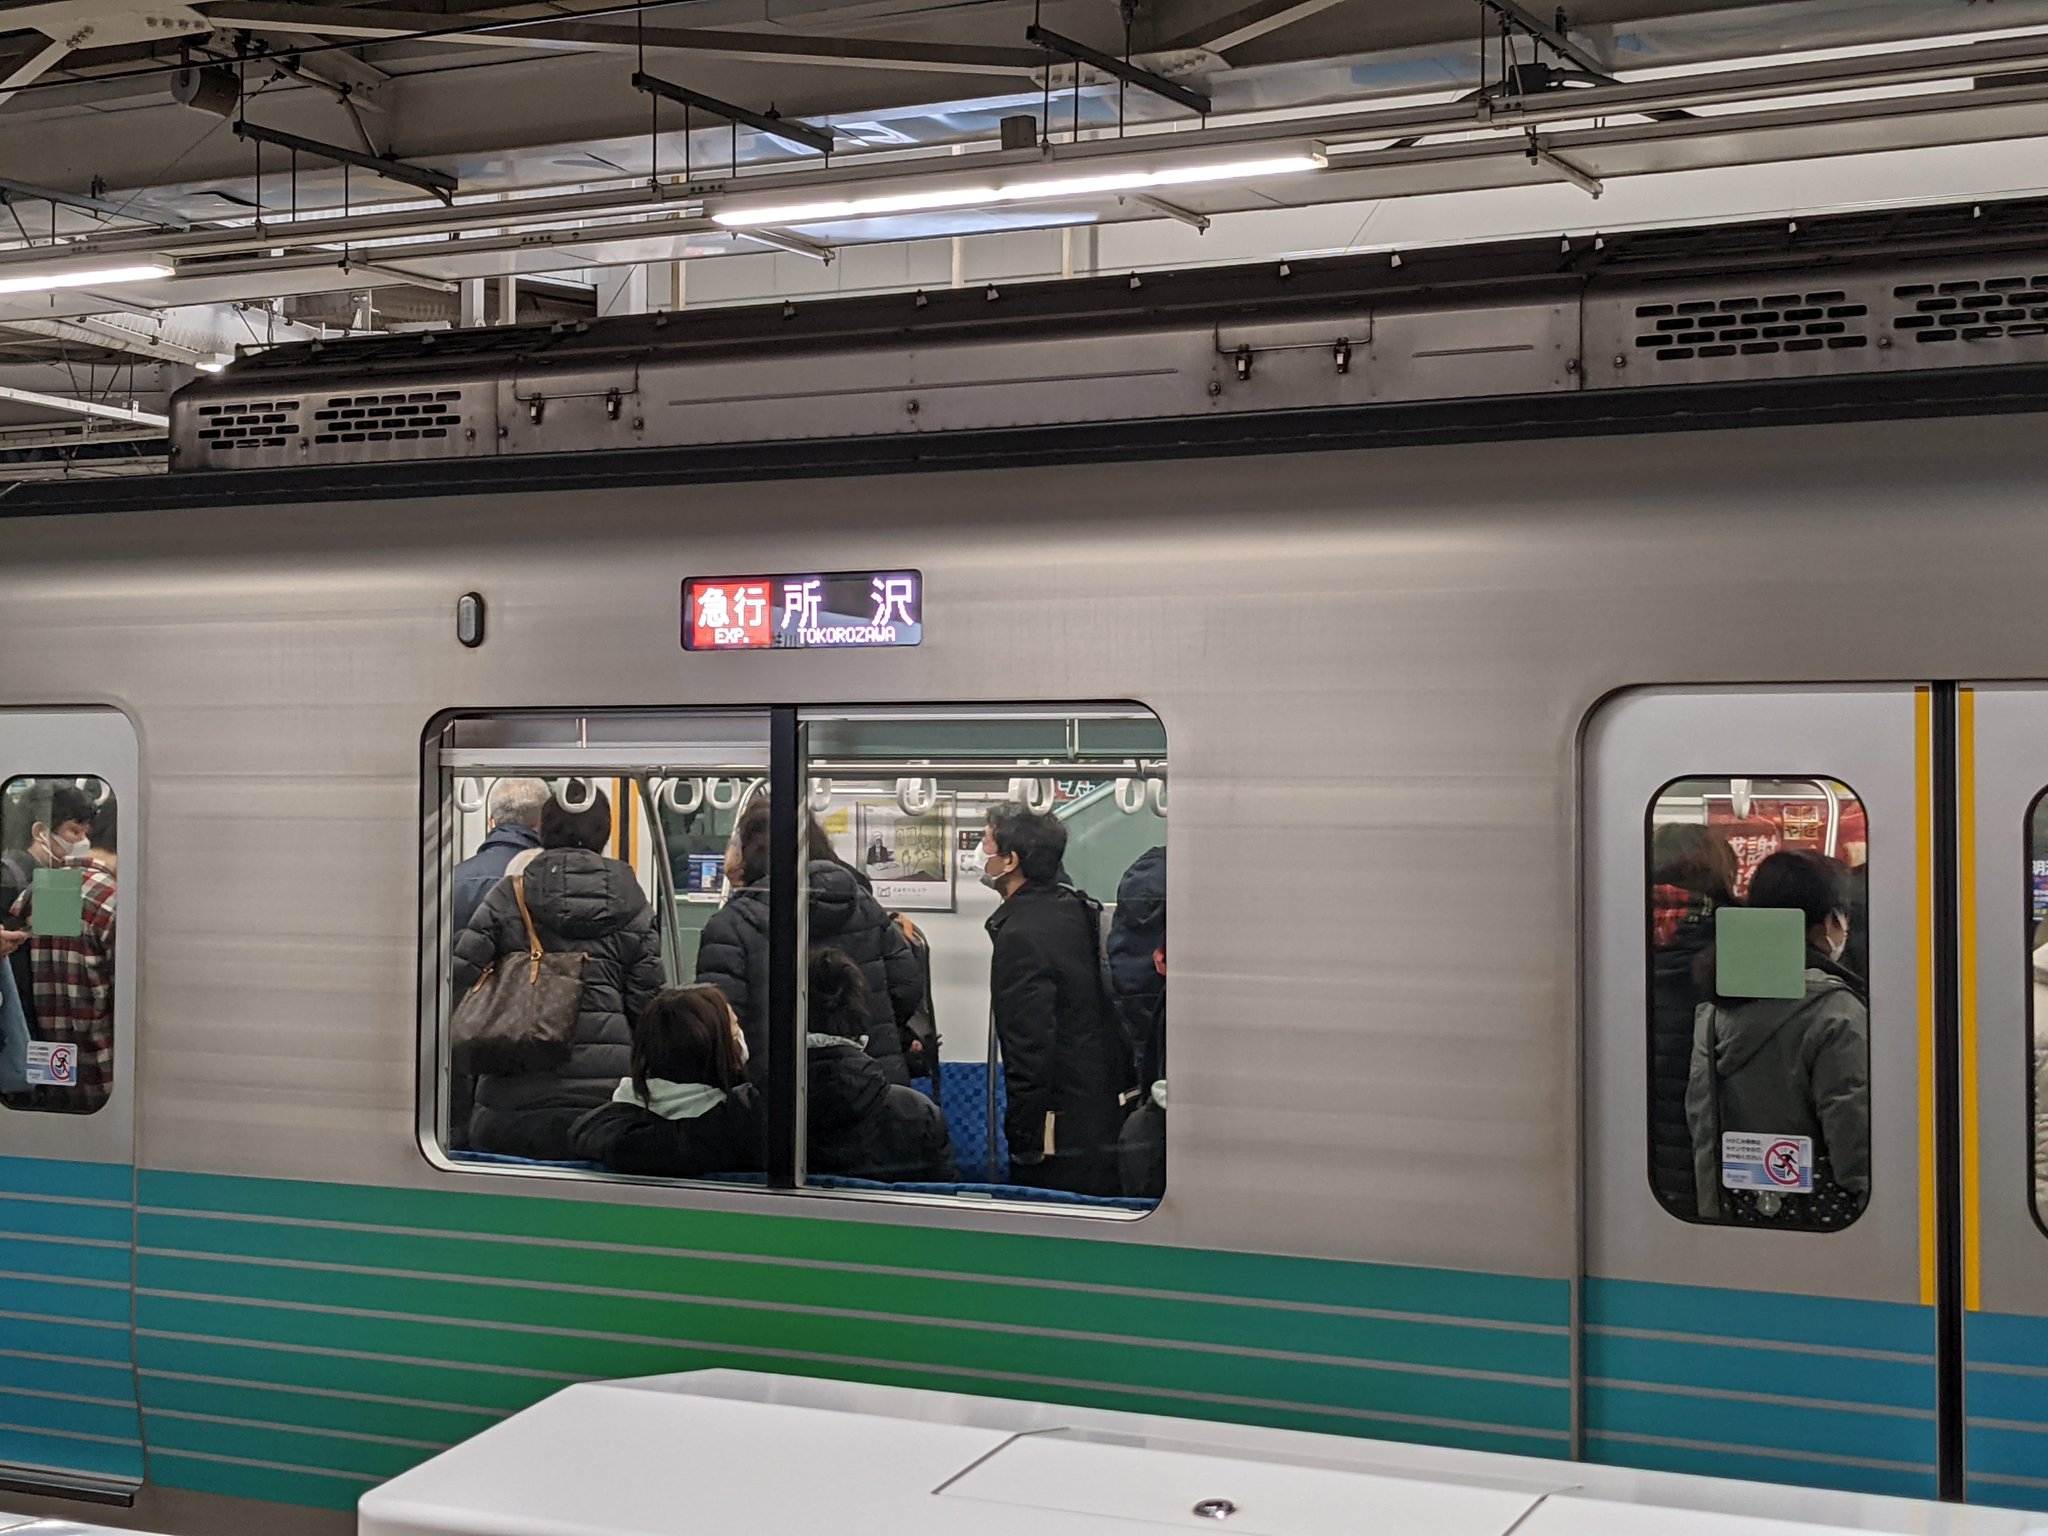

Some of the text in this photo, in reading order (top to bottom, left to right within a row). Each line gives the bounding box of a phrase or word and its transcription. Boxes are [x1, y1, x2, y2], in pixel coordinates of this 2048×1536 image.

[697, 577, 914, 629] 急行 所沢
[714, 627, 750, 644] EXP.
[797, 626, 896, 644] TOKOROZAWA
